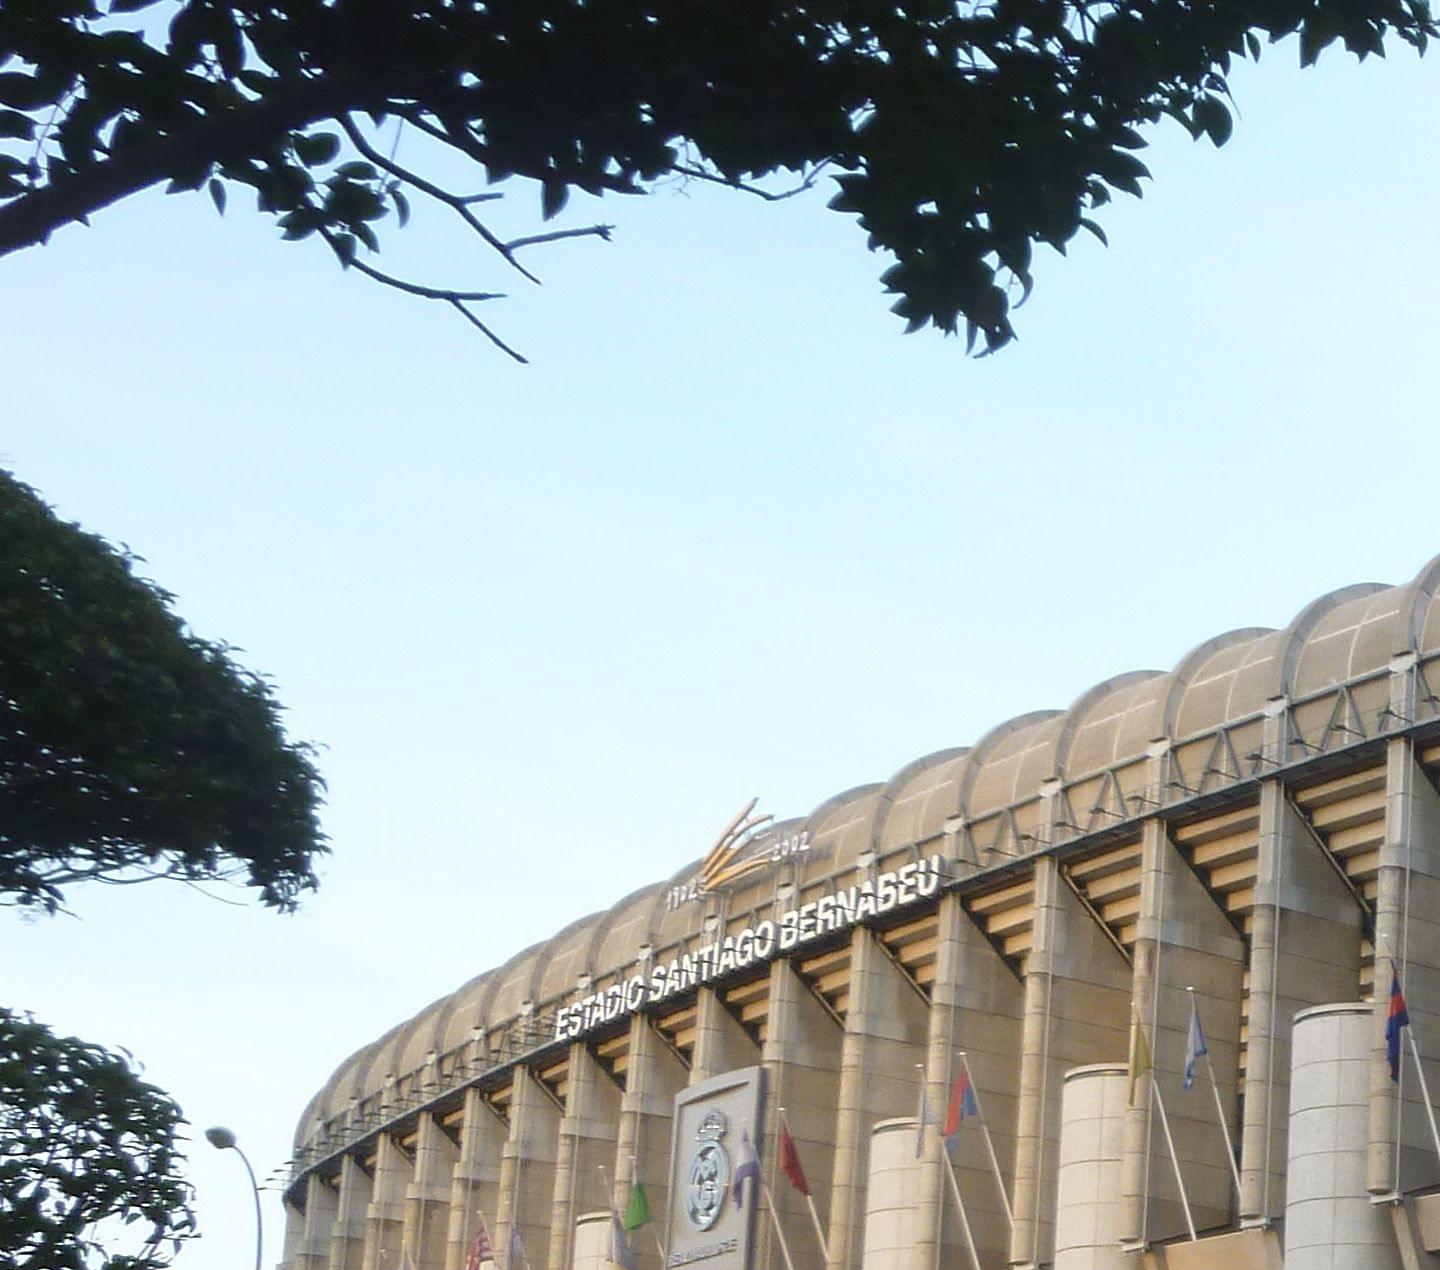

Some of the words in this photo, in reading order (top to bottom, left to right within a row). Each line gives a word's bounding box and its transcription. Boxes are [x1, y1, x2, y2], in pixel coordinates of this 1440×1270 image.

[770, 831, 810, 862] 2002
[555, 975, 645, 1042] ESTADIO
[648, 921, 774, 1002] SANTIAGO
[779, 854, 943, 950] BERNABEU
